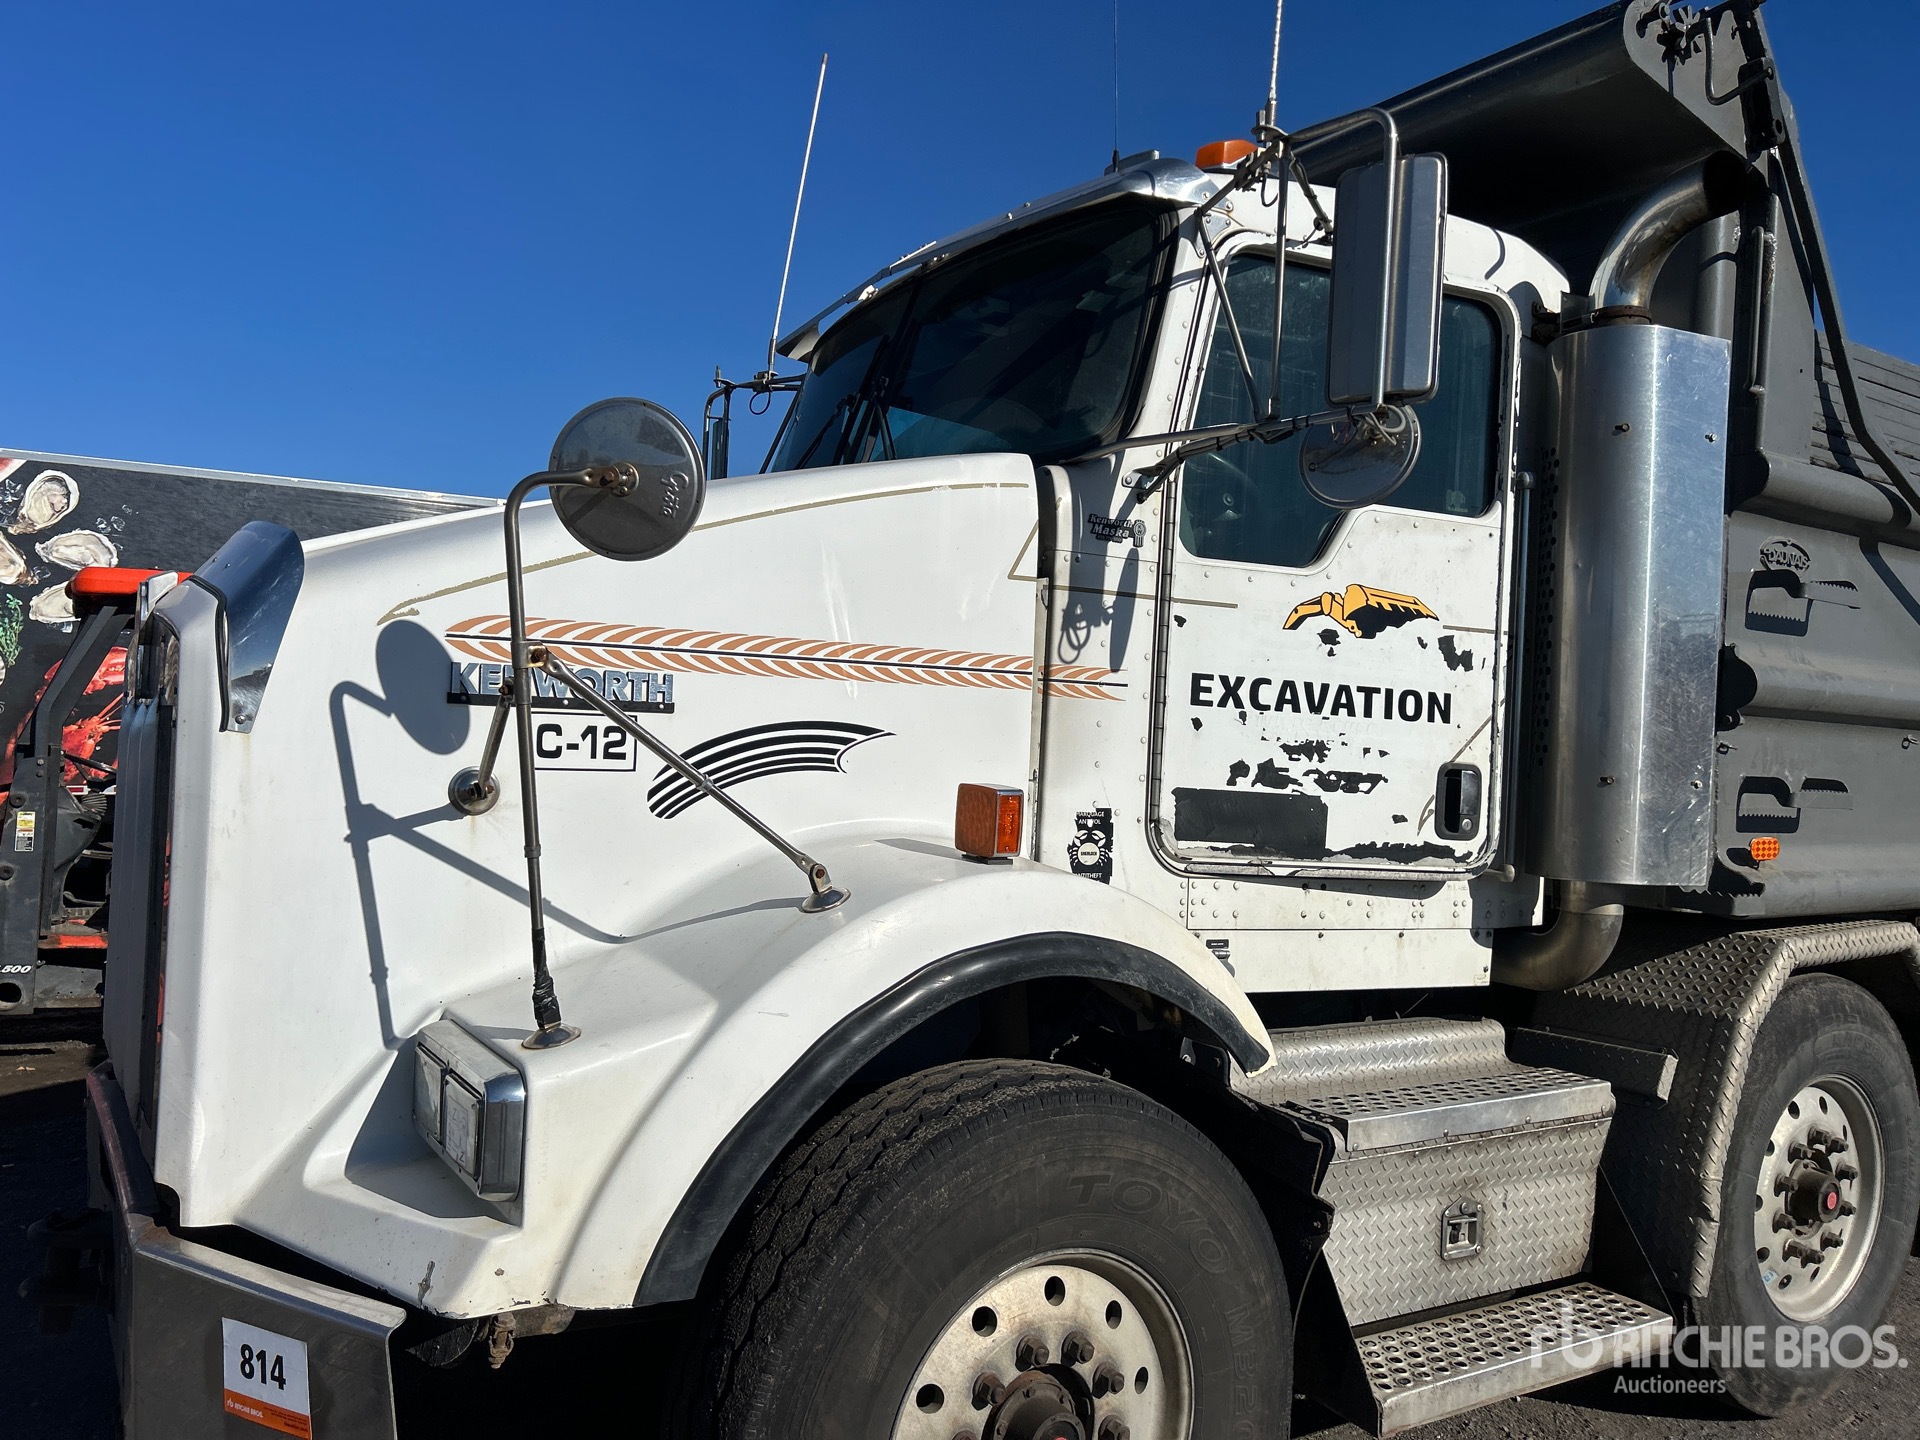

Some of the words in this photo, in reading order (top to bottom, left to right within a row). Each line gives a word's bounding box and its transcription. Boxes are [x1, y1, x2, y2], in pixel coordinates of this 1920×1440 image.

[1090, 514, 1133, 528] Kenworth
[1092, 523, 1130, 538] Maska
[1189, 671, 1452, 725] EXCAVATION
[536, 723, 627, 761] C-12
[0, 964, 32, 974] 500
[1068, 1171, 1231, 1276] TOYO
[240, 1343, 286, 1391] 814
